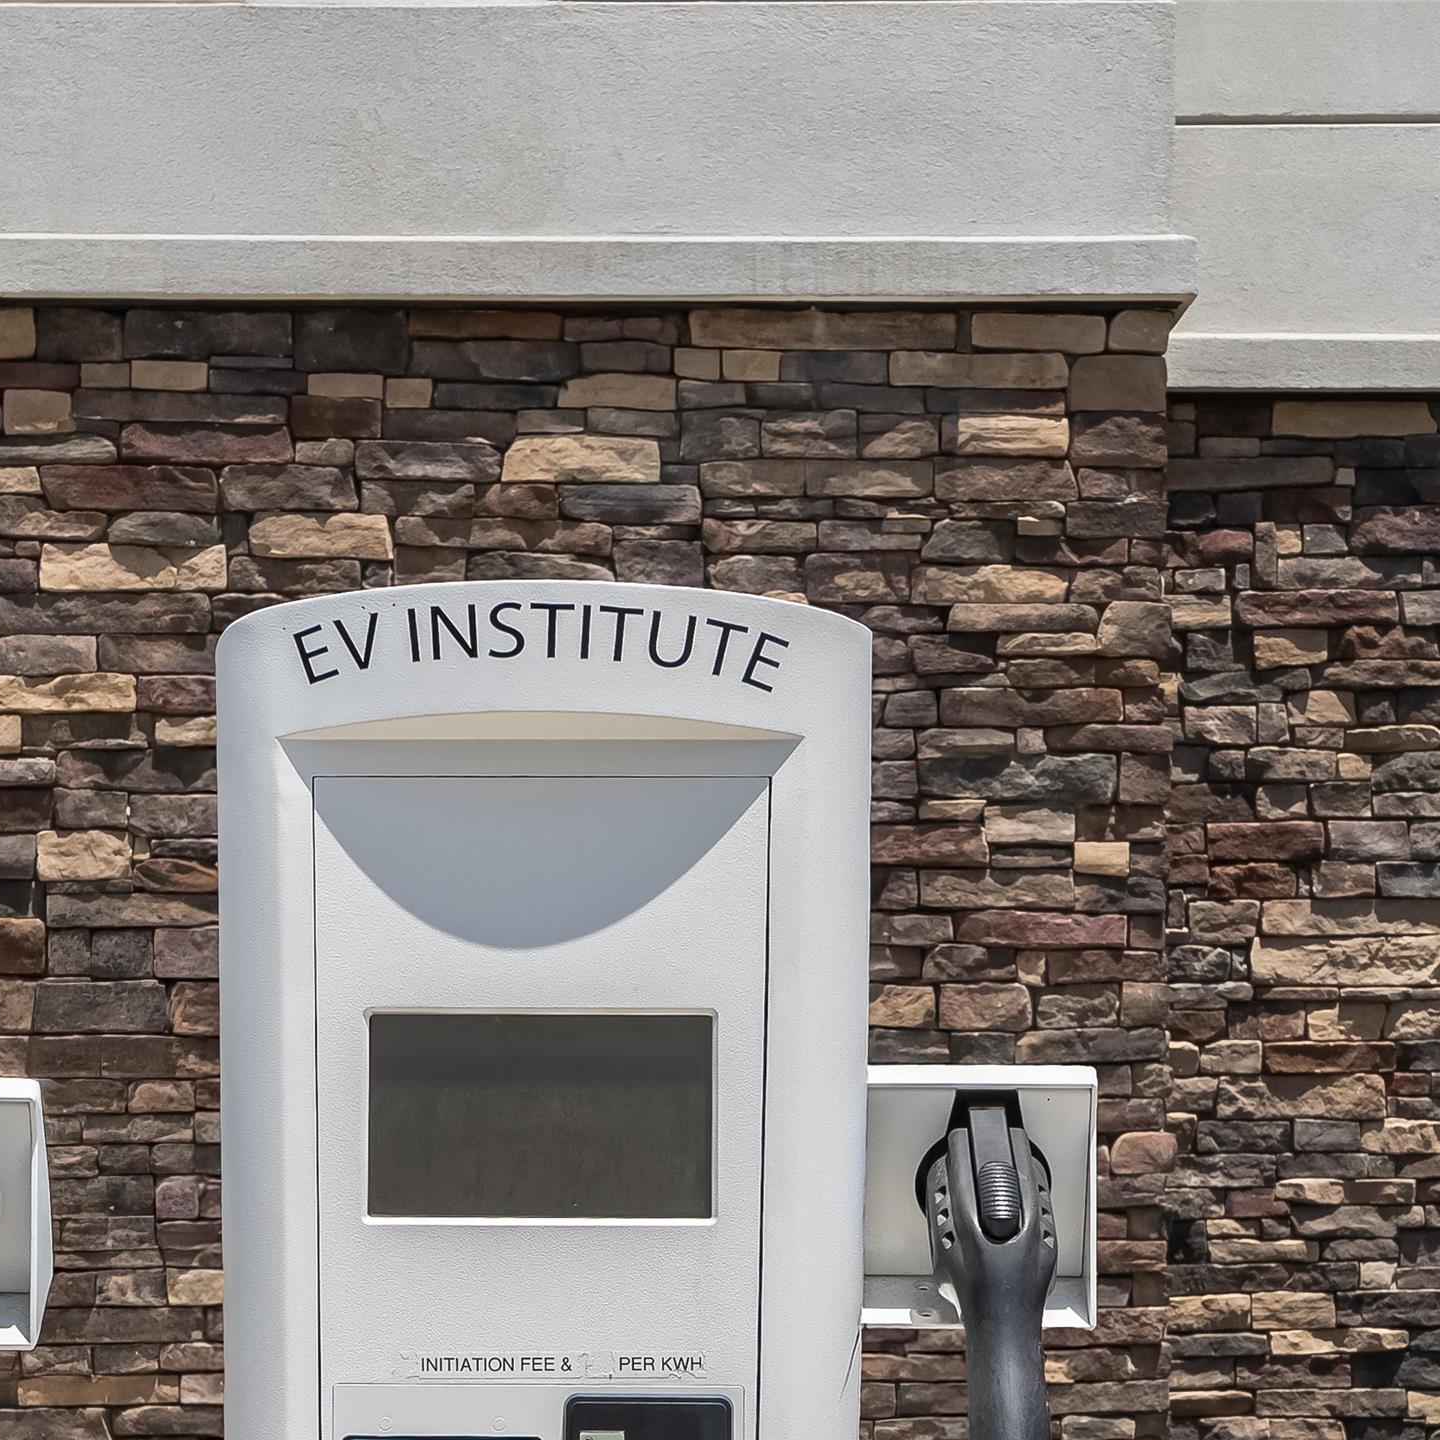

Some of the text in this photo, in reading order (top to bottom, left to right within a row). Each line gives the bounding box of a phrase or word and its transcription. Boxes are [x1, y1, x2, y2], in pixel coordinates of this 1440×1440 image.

[293, 601, 790, 692] EV INSTITUTE
[421, 1356, 572, 1372] INITIATION FEE &
[619, 1357, 702, 1372] PER KWH
